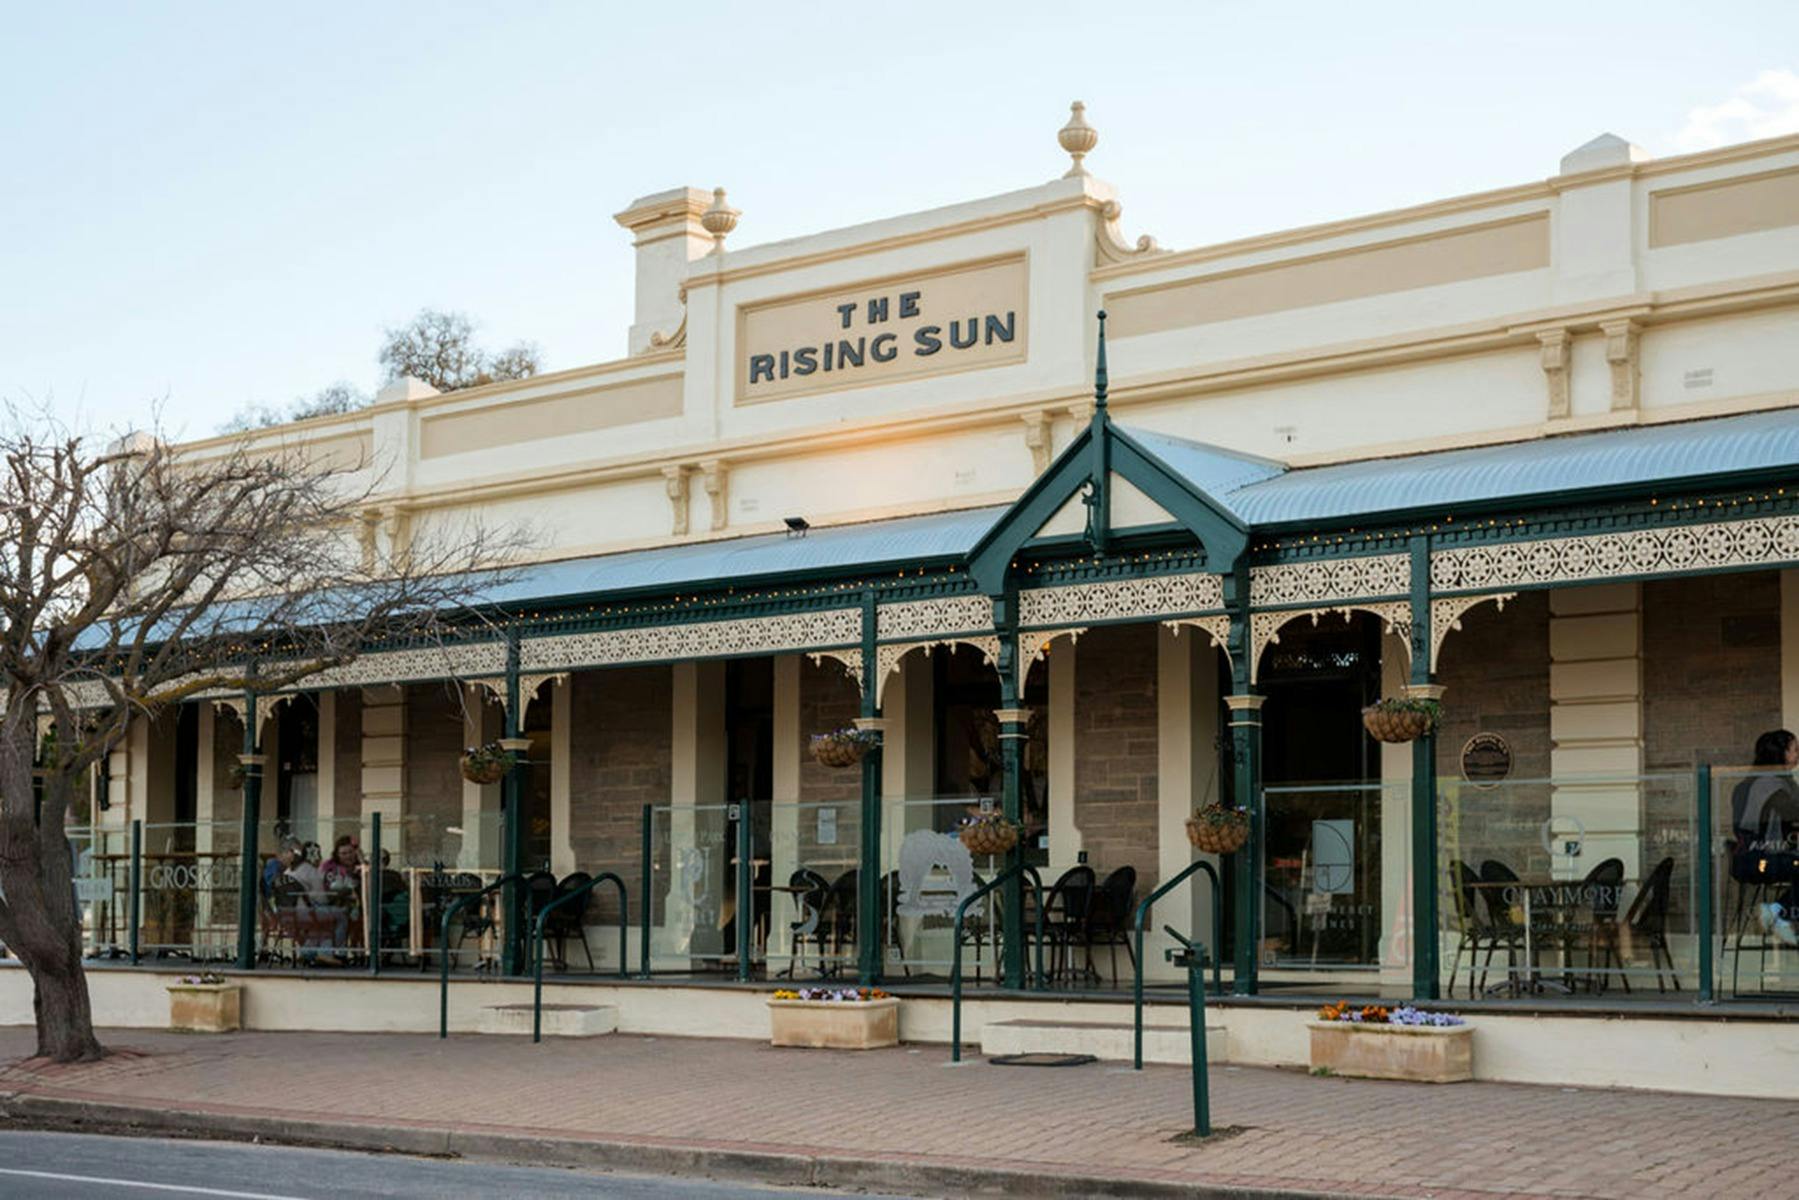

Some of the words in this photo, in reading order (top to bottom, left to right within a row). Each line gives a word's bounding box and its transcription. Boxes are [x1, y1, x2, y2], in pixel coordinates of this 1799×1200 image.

[837, 291, 921, 329] THE
[750, 333, 898, 383] RISING
[913, 311, 1015, 357] SUN
